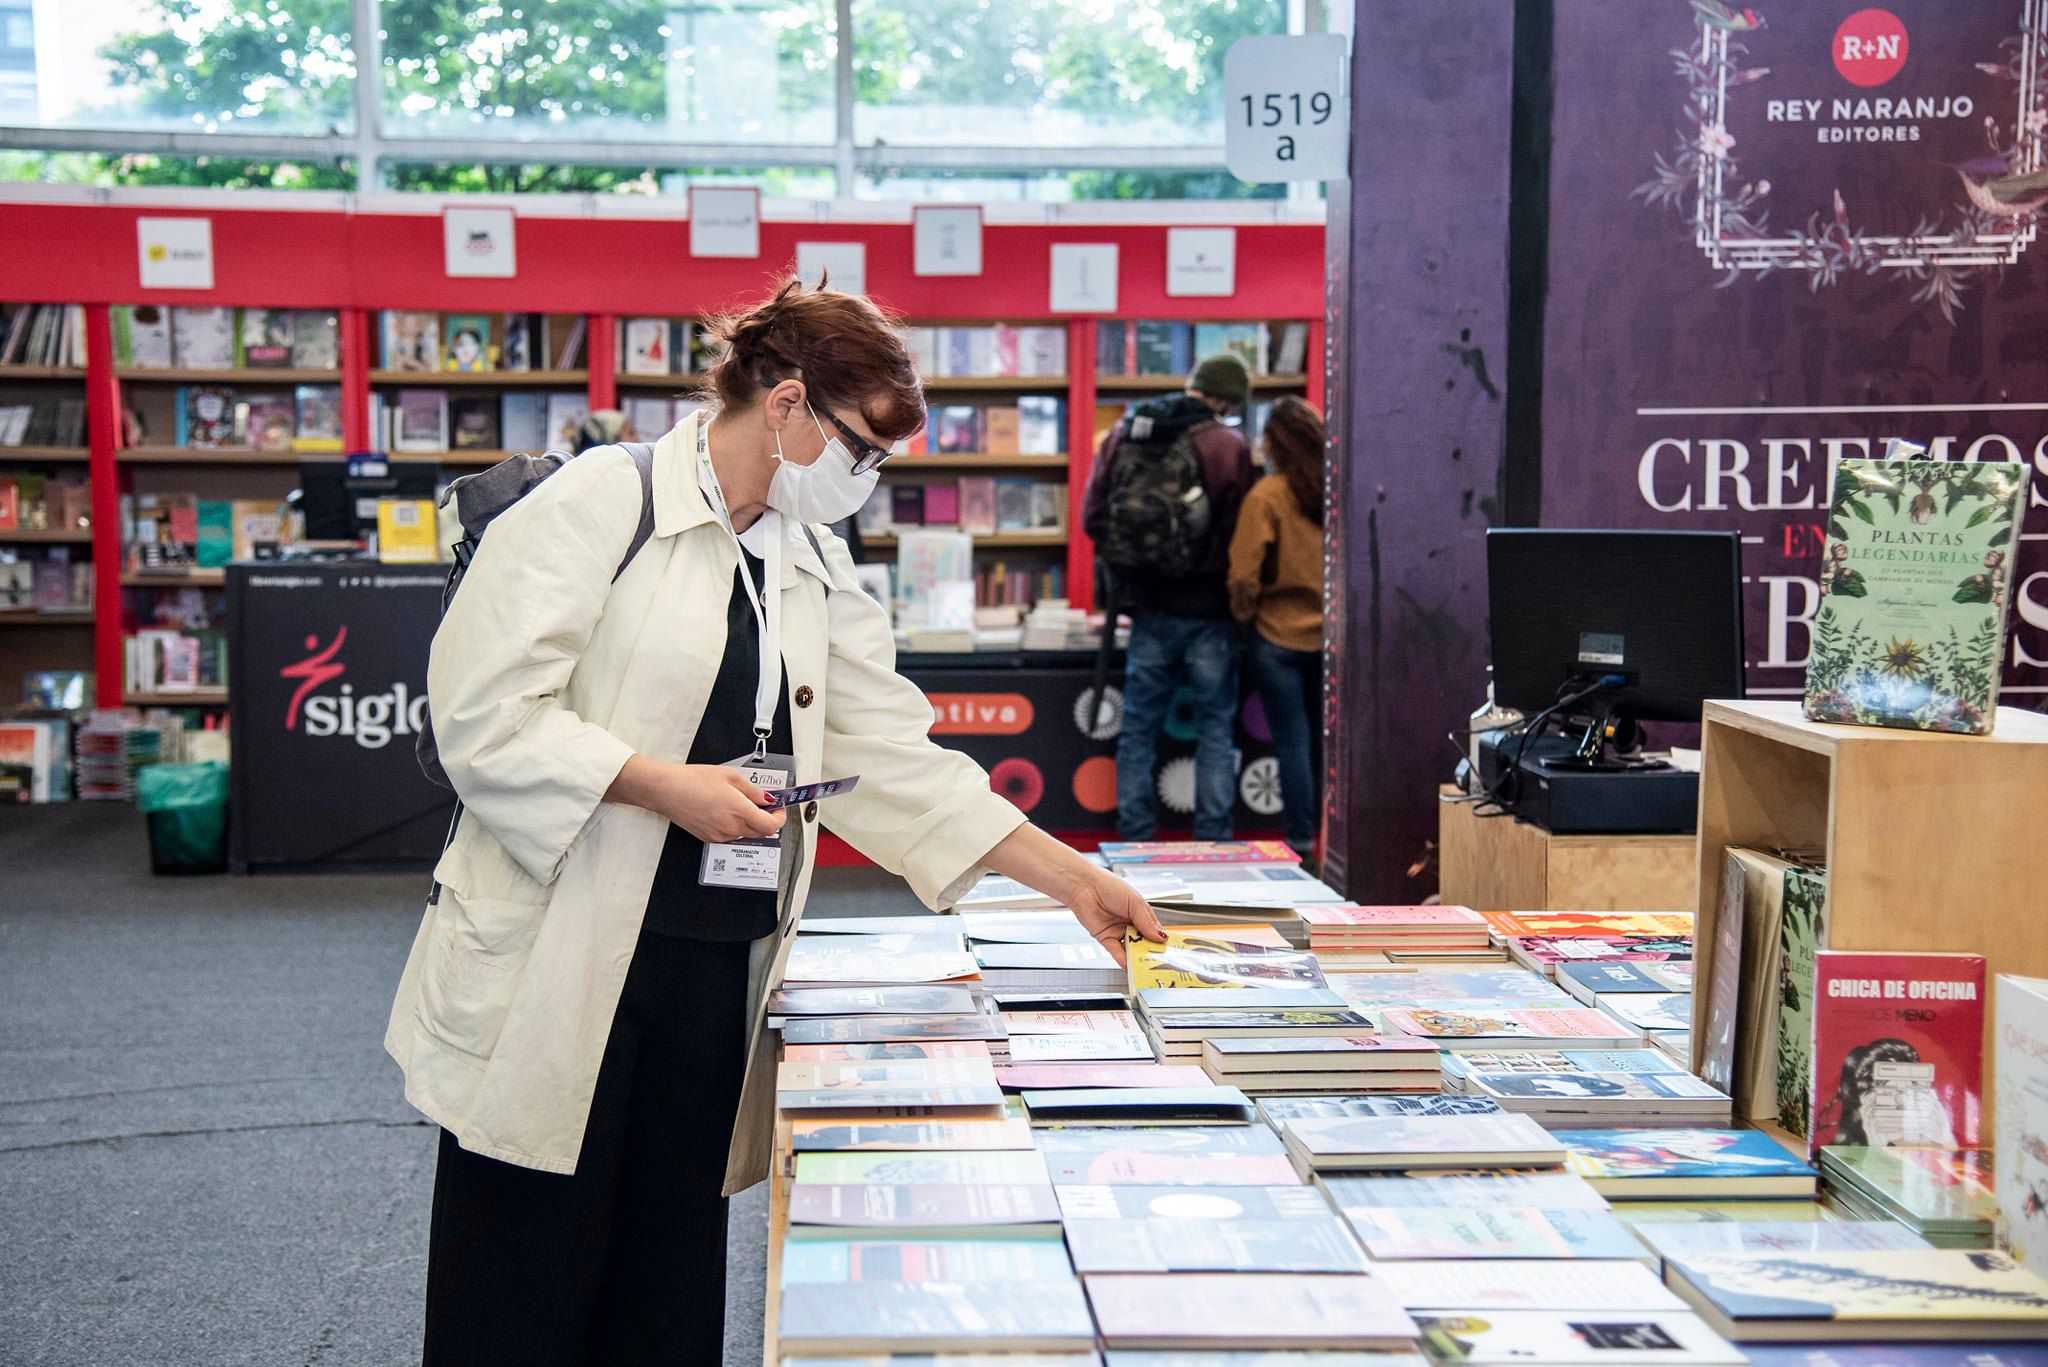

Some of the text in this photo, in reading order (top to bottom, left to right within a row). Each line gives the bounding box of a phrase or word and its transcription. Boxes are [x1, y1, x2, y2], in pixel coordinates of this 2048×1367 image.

[1842, 34, 1901, 61] R+N
[1241, 91, 1332, 127] 1519
[1766, 96, 1974, 122] REY NARANJO
[1817, 125, 1921, 143] EDITORES
[1276, 135, 1296, 161] a
[1871, 529, 1965, 547] PLANTAS
[1851, 547, 1980, 565] LEGENDARIAS
[1828, 978, 1977, 1001] CHICA DE OFICINA
[1896, 1009, 1937, 1022] MENO
